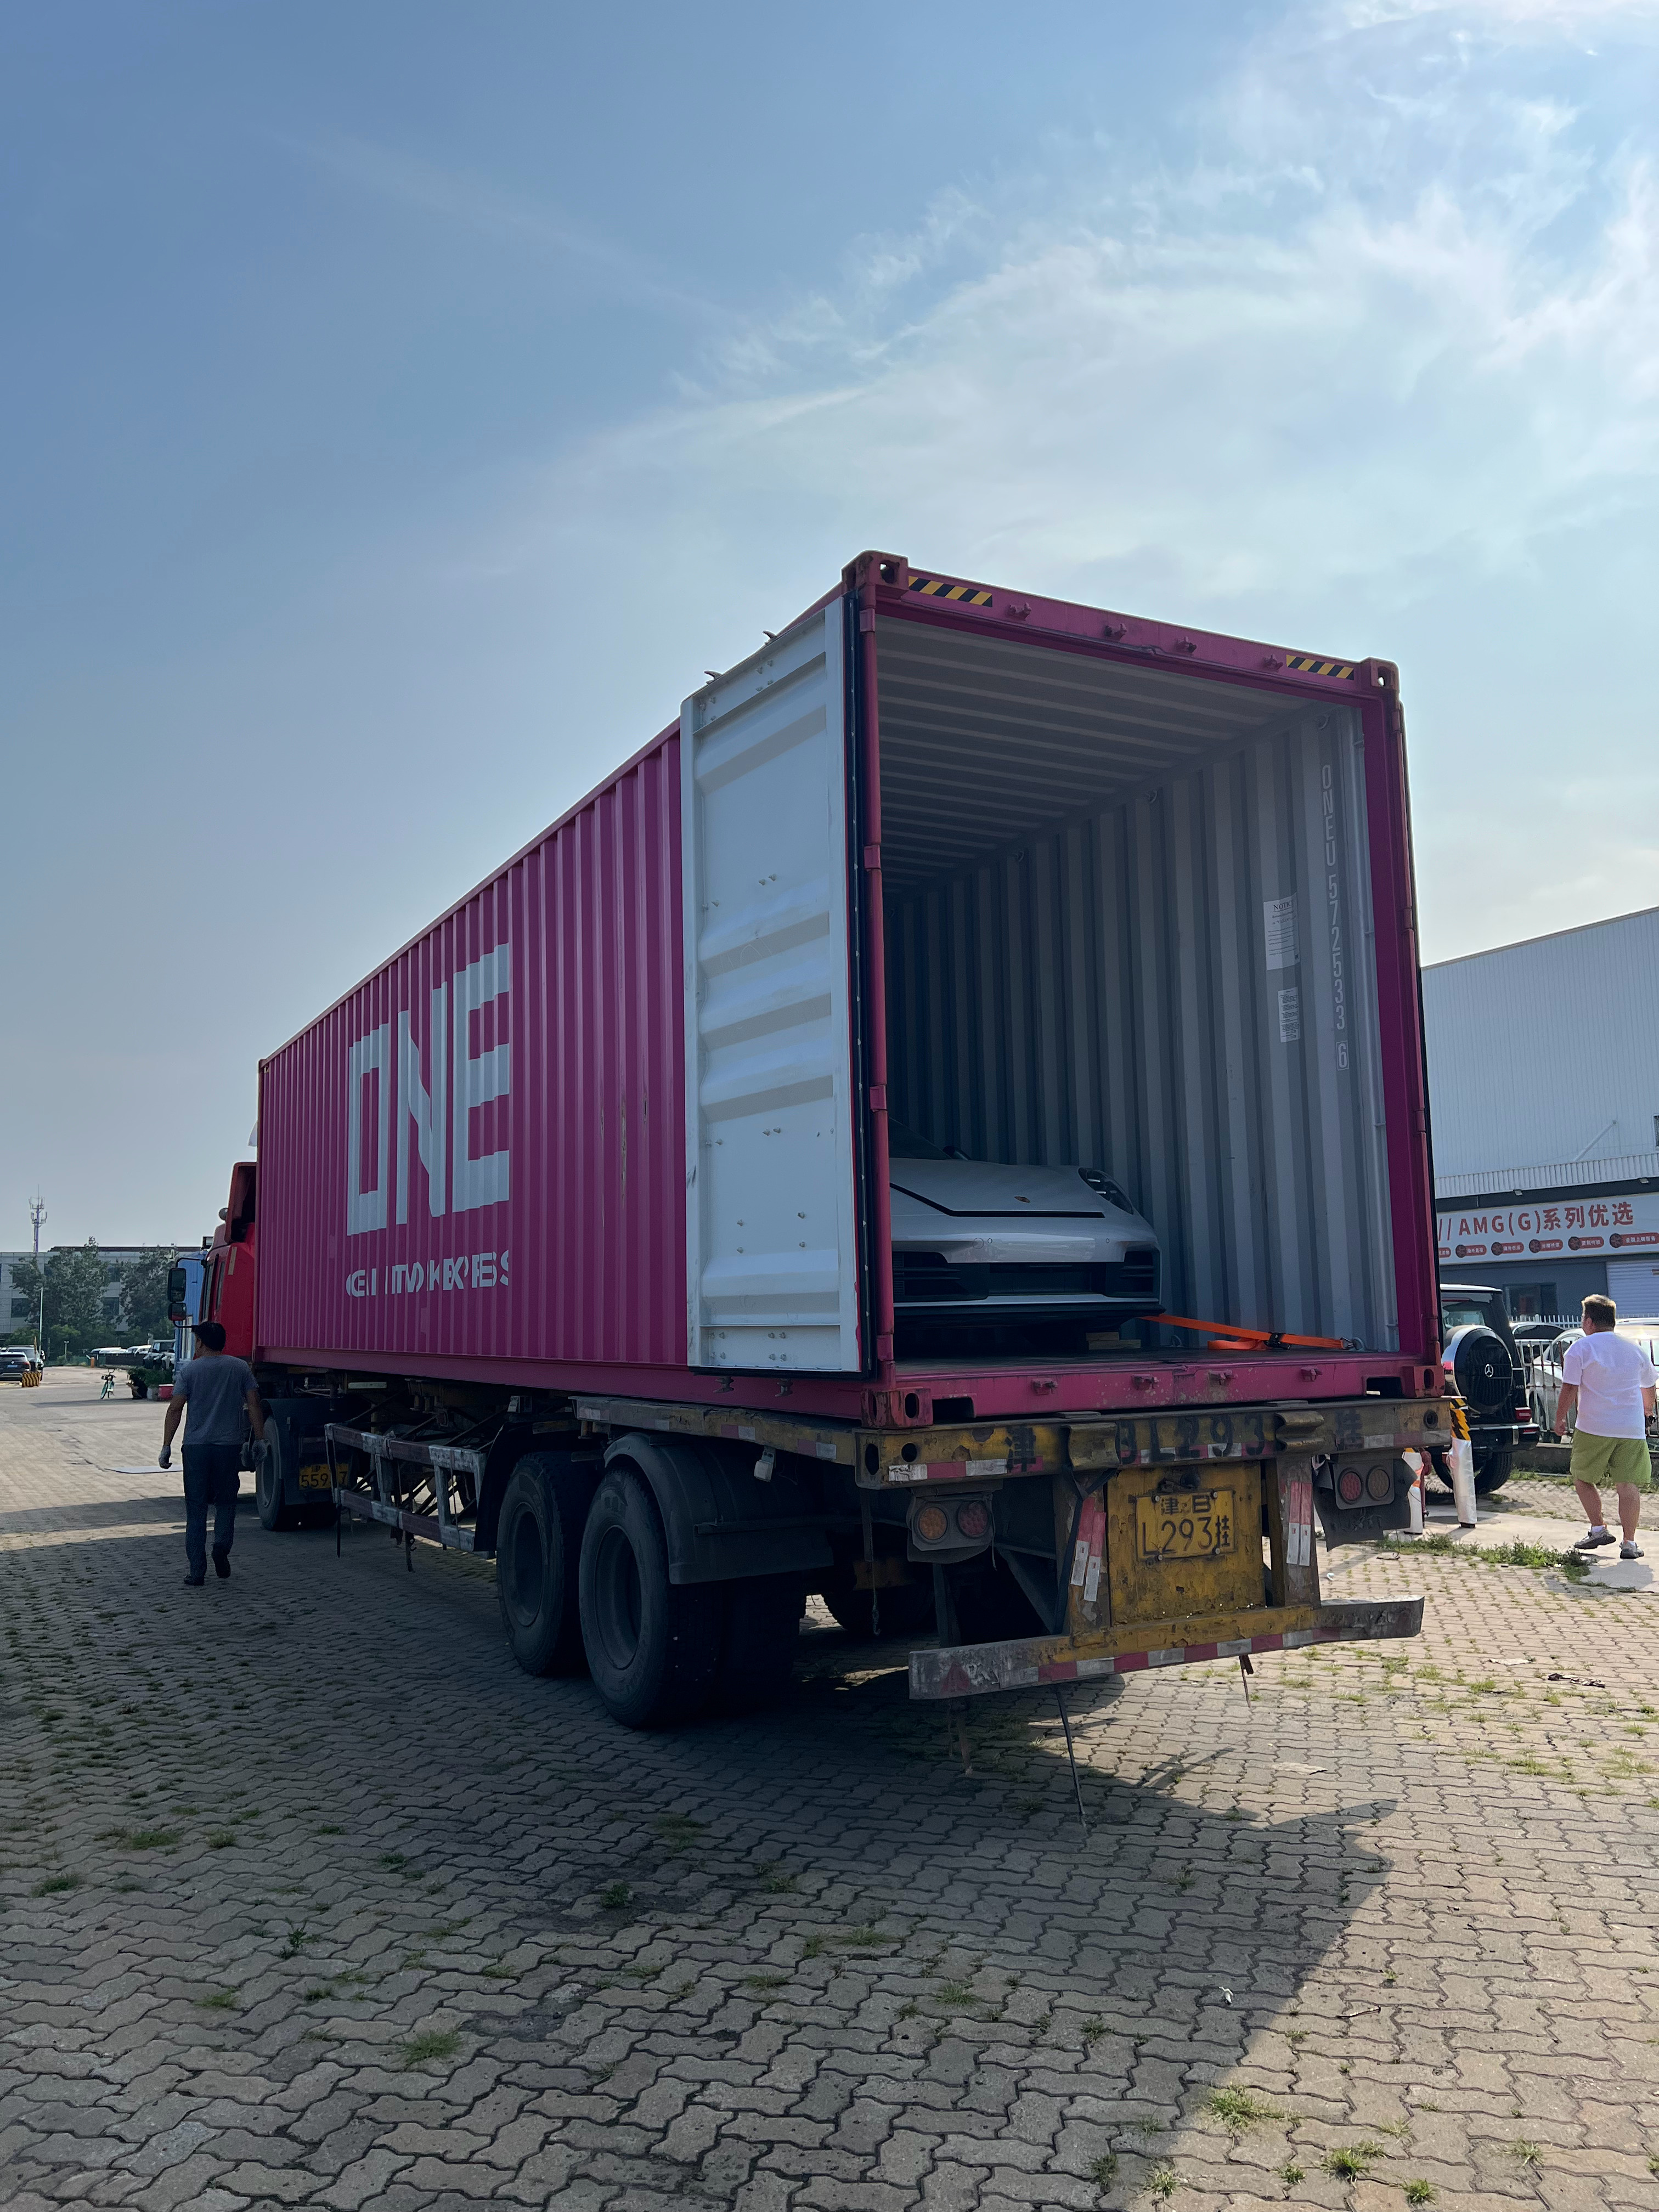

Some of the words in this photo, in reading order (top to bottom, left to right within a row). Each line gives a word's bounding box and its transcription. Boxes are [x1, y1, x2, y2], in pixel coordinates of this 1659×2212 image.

[1322, 764, 1336, 866] ONEU
[1273, 900, 1293, 911] NOTIC
[1328, 874, 1345, 1030] 572533
[347, 943, 510, 1235] ONE
[1337, 1042, 1348, 1069] 6
[1142, 1515, 1231, 1556] L293挂
